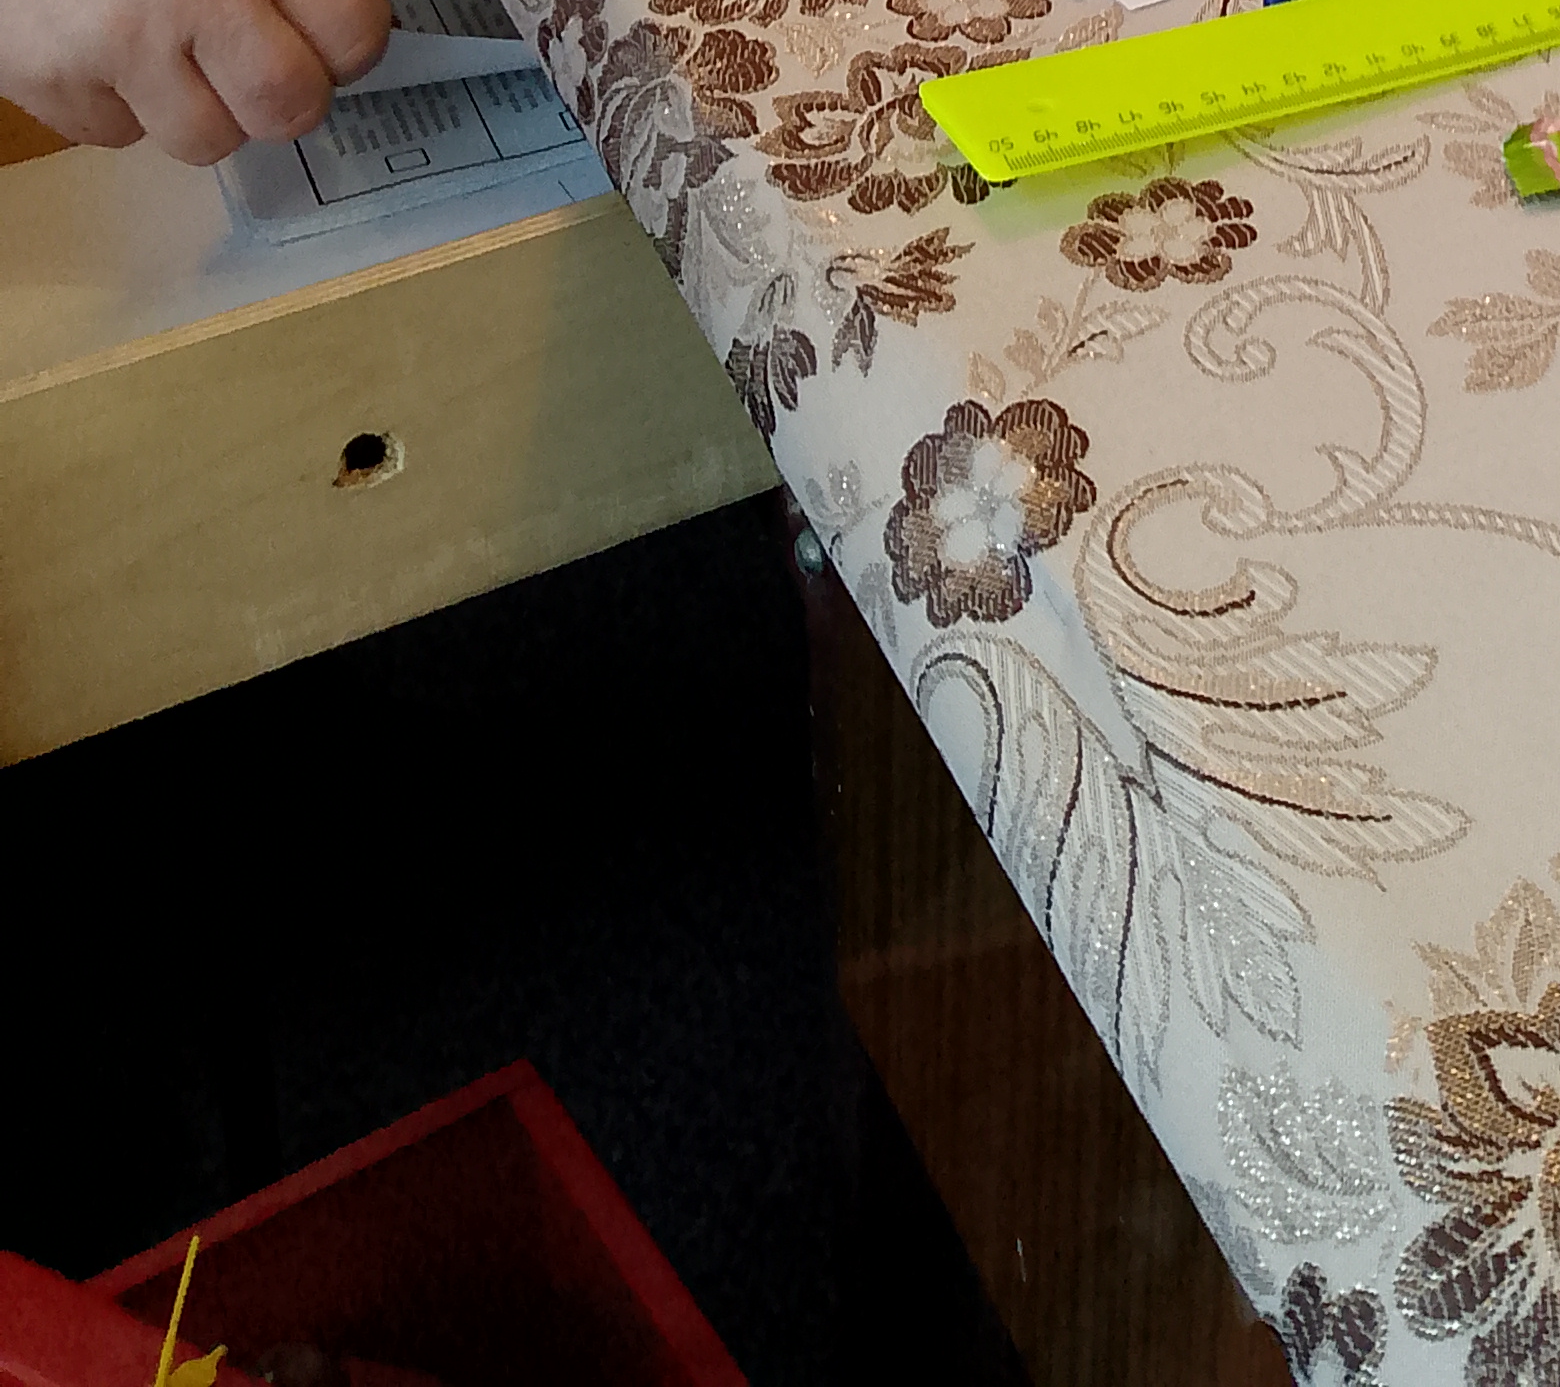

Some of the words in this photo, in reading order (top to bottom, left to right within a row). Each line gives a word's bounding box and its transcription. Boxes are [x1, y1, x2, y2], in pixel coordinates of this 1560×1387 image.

[1282, 71, 1307, 87] 43
[1241, 81, 1267, 97] 44
[1200, 90, 1226, 106] 45
[1158, 100, 1185, 116] 46
[1118, 109, 1143, 126] 47
[1032, 127, 1058, 144] 49
[1075, 119, 1102, 136] 48
[987, 136, 1015, 155] 50
